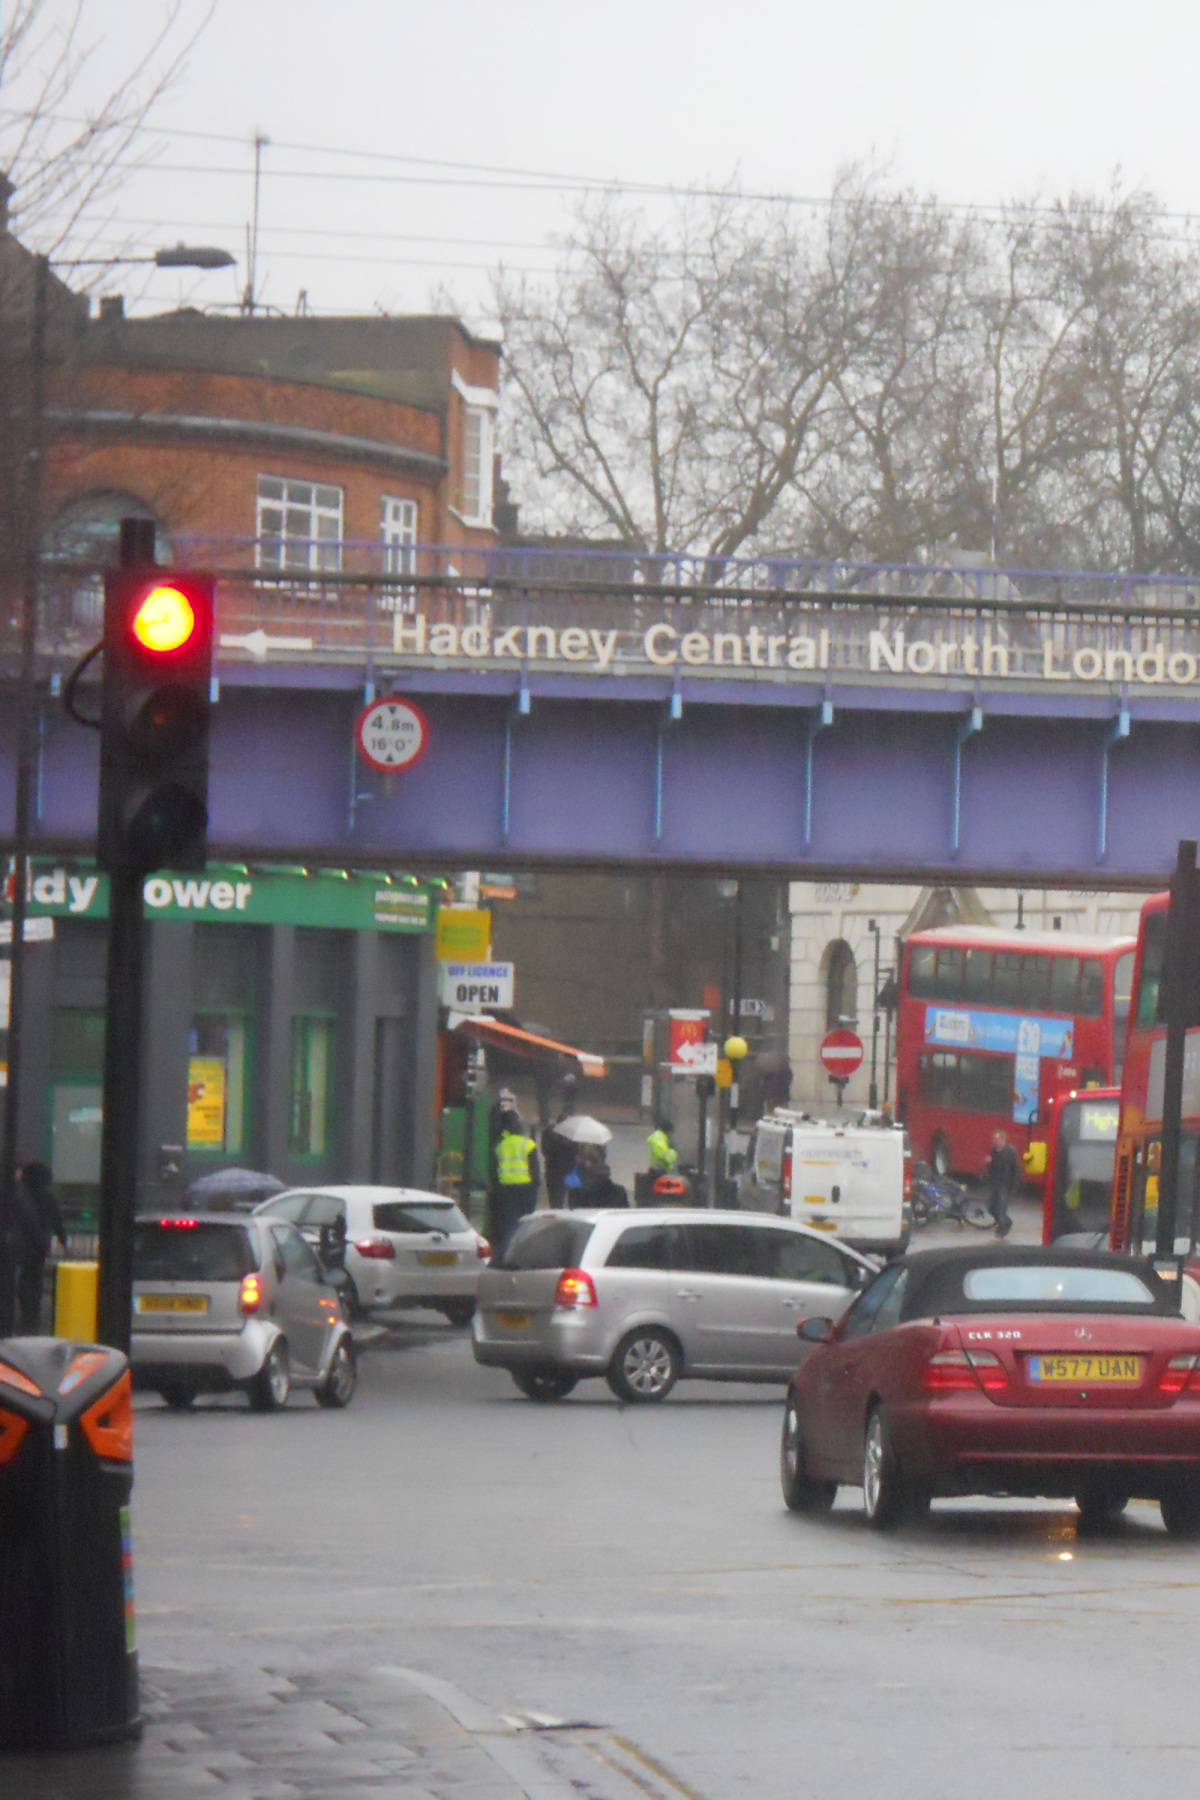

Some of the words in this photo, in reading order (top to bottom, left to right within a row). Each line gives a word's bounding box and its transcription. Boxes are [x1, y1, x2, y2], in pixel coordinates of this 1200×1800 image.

[393, 614, 617, 669] Hackney
[644, 622, 828, 669] Central
[869, 631, 1008, 676] North
[143, 877, 252, 911] ower
[467, 966, 508, 978] LICENCE
[456, 984, 499, 1003] OPEN
[1043, 1360, 1093, 1377] W577
[1099, 1361, 1136, 1377] UAN
